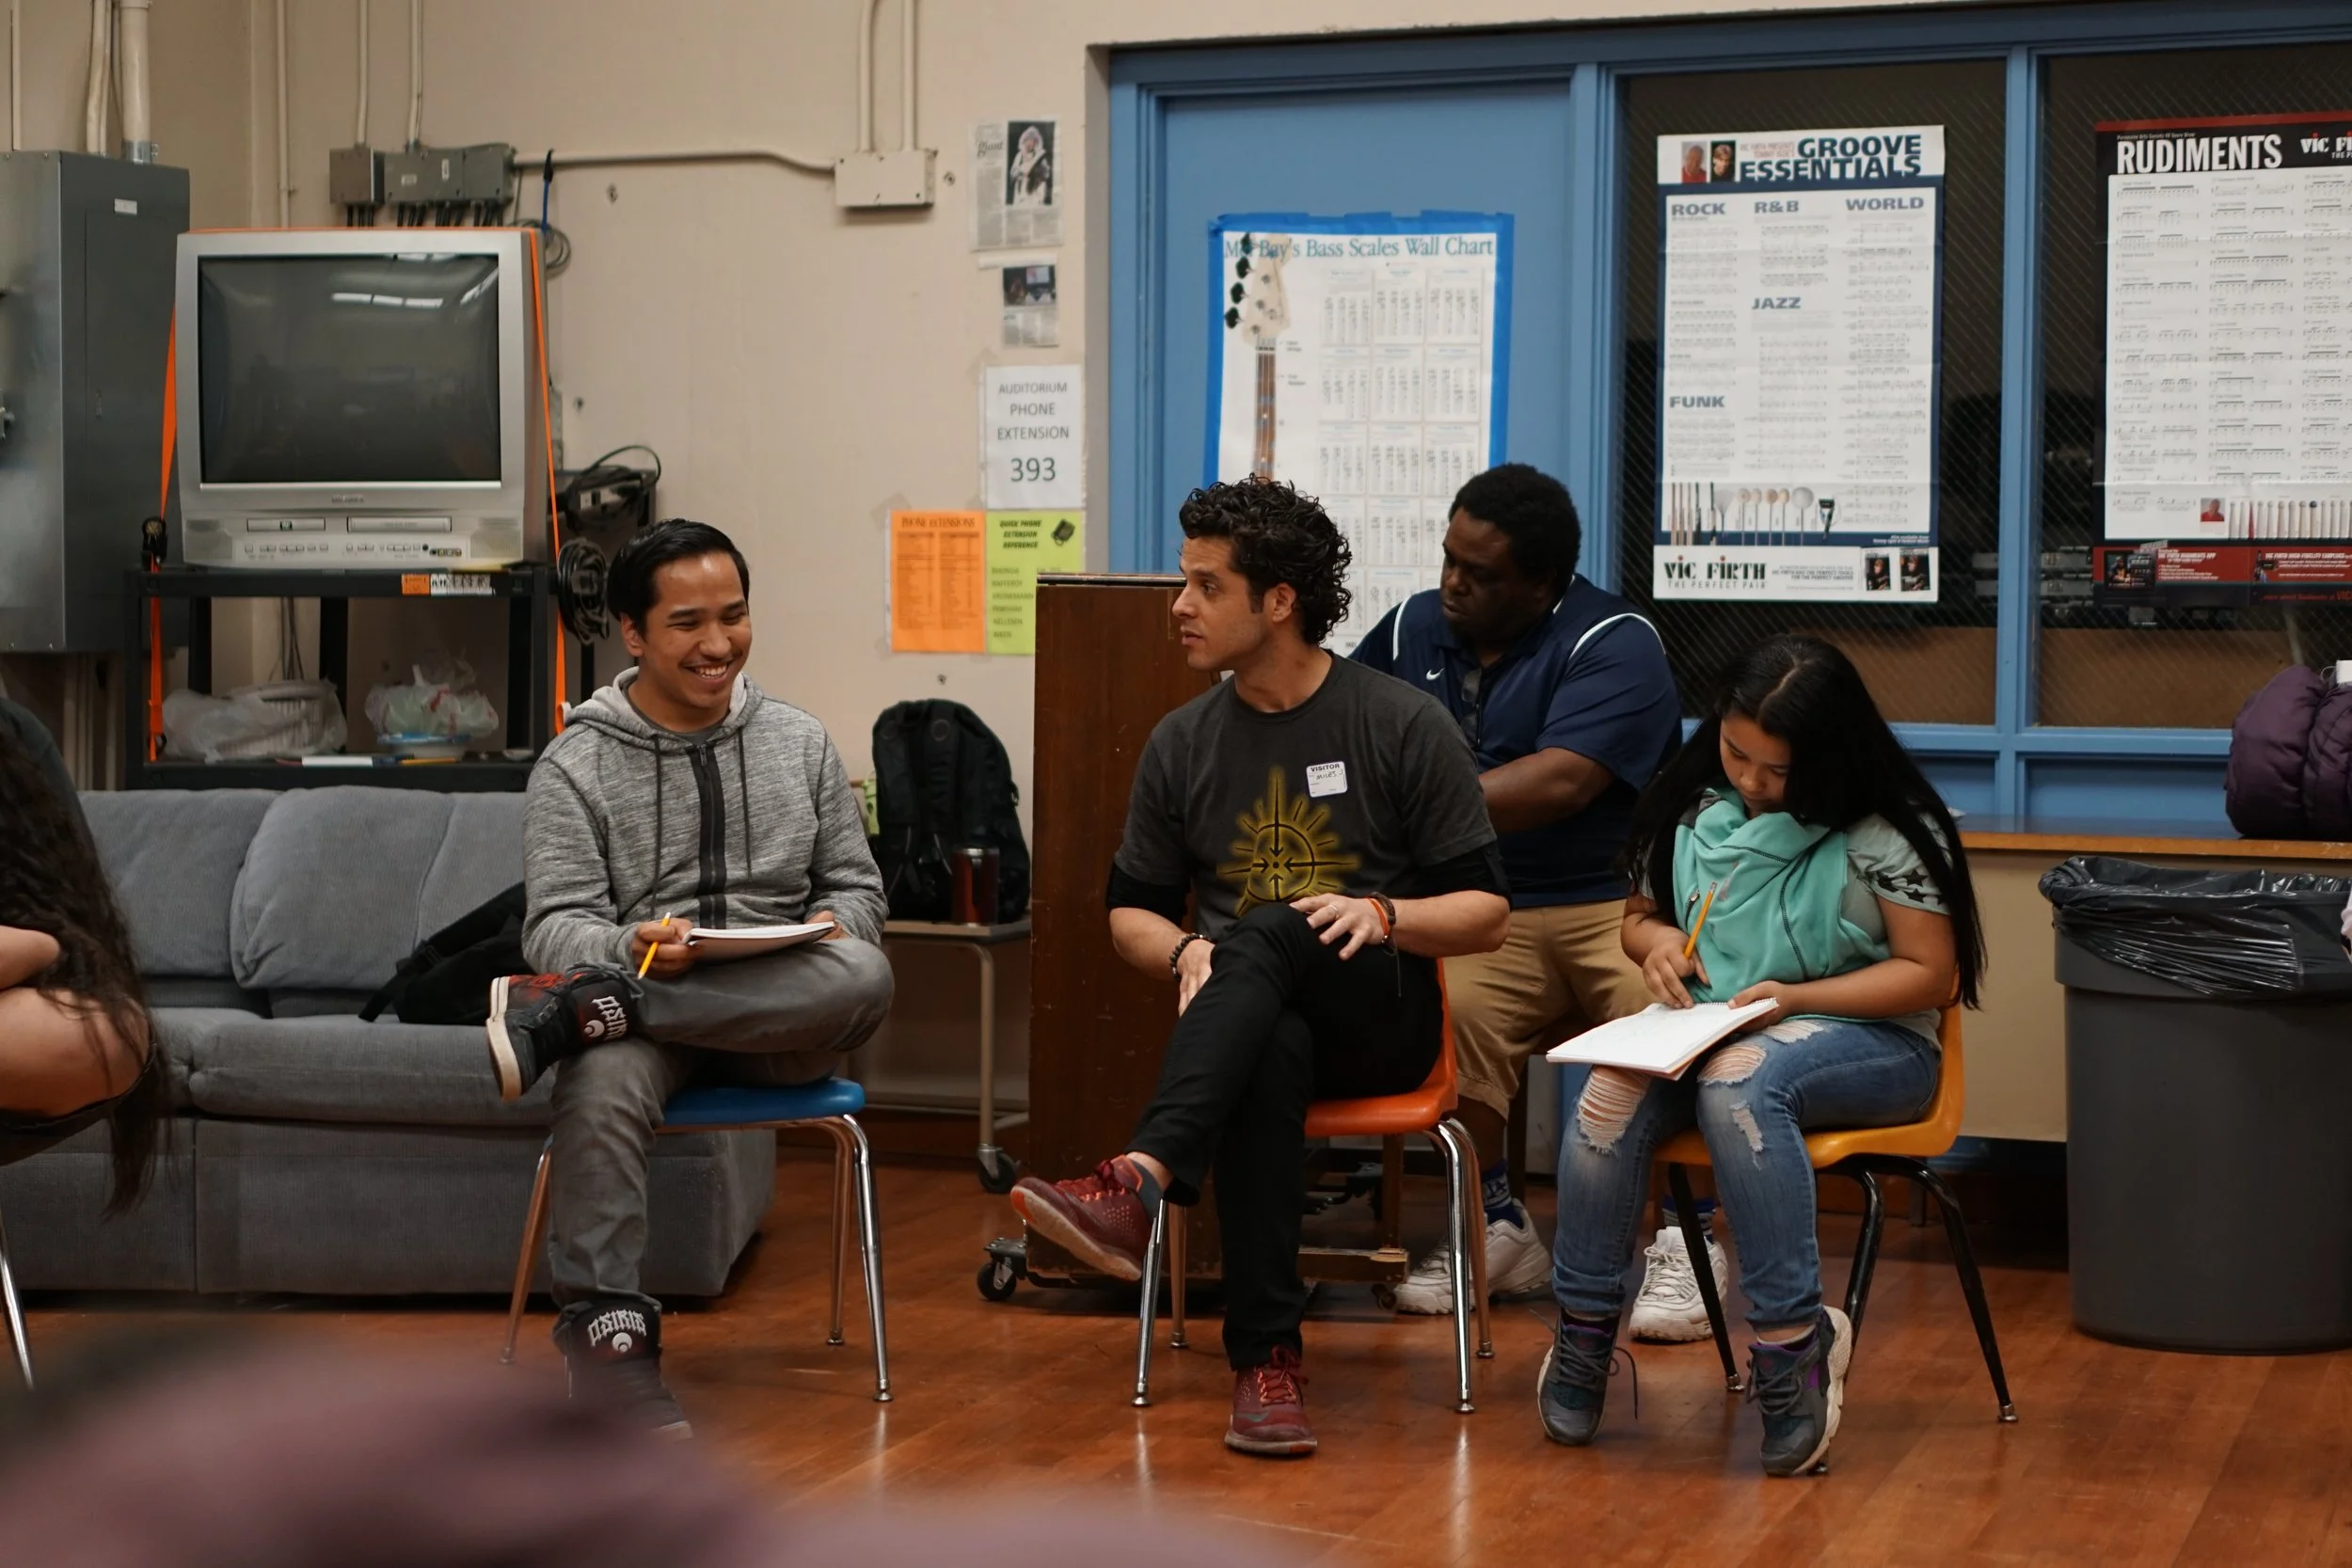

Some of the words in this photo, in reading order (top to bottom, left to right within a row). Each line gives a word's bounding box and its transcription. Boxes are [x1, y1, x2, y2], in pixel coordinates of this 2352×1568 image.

[1797, 135, 1922, 159] GROOVE
[2117, 134, 2282, 175] RUDIMENTS
[1740, 155, 1922, 182] ESSENTIALS
[1671, 203, 1726, 216] ROCK
[1846, 197, 1924, 211] WORLD
[1306, 239, 1344, 258] Bass
[1348, 237, 1400, 258] Scales
[1405, 237, 1440, 257] Wall
[1445, 236, 1494, 256] Chart
[1752, 297, 1802, 309] JAZZ
[998, 382, 1068, 395] AUDITORIUM
[1669, 396, 1725, 408] FUNK
[1010, 403, 1057, 417] PHONE
[997, 426, 1070, 441] EXTENSION
[1010, 457, 1057, 483] 393
[901, 516, 927, 529] PHONE
[929, 516, 976, 529] EXTENSIONS
[999, 520, 1019, 529] QUICK
[1020, 519, 1041, 528] PHONE
[1003, 531, 1038, 539] EXTENSION
[1003, 541, 1039, 549] REFERENCE
[1692, 580, 1737, 589] PERFECT
[1743, 580, 1767, 589] PAIR
[1311, 763, 1340, 772] VISITOR
[587, 1308, 647, 1348] OSIRIS
